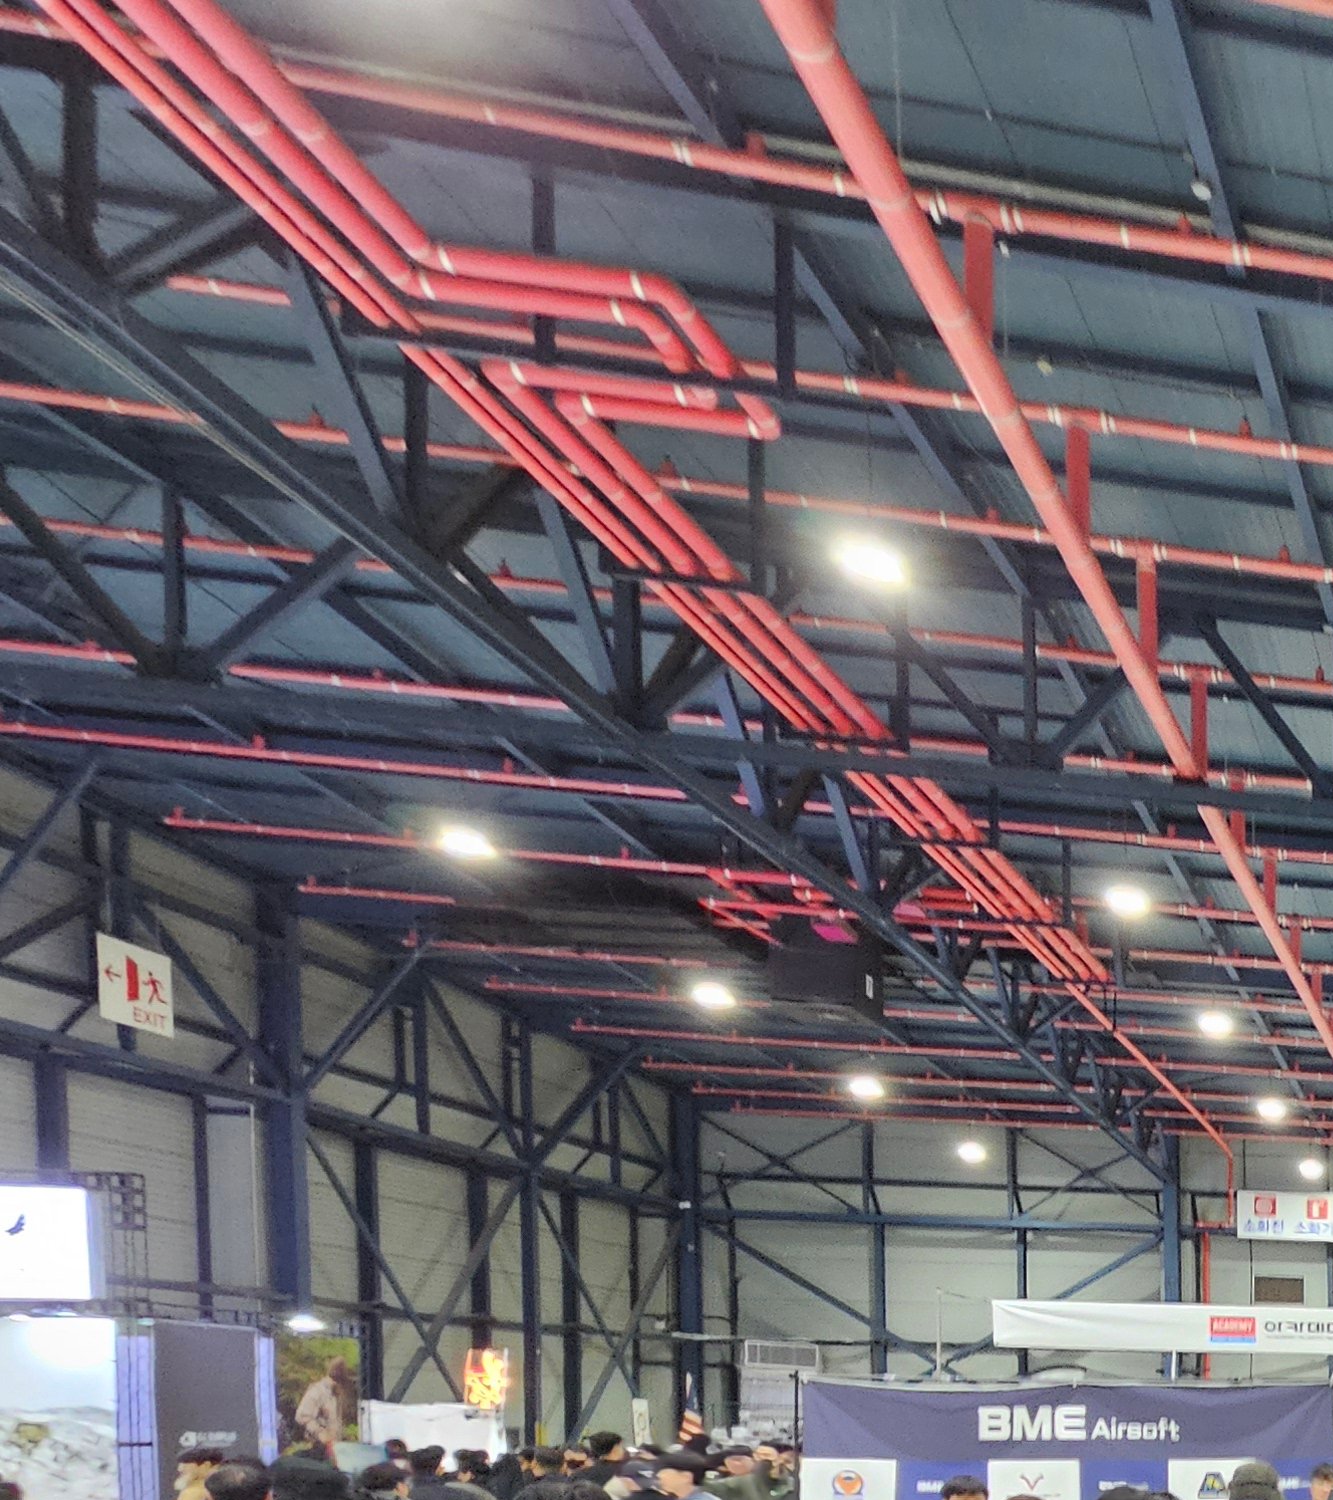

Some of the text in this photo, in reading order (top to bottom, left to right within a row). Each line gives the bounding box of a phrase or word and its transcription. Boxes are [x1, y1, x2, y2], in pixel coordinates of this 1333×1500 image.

[132, 1005, 168, 1030] EXIT
[1212, 1317, 1254, 1333] ACADEMY
[978, 1404, 1180, 1441] BME Airsoft
